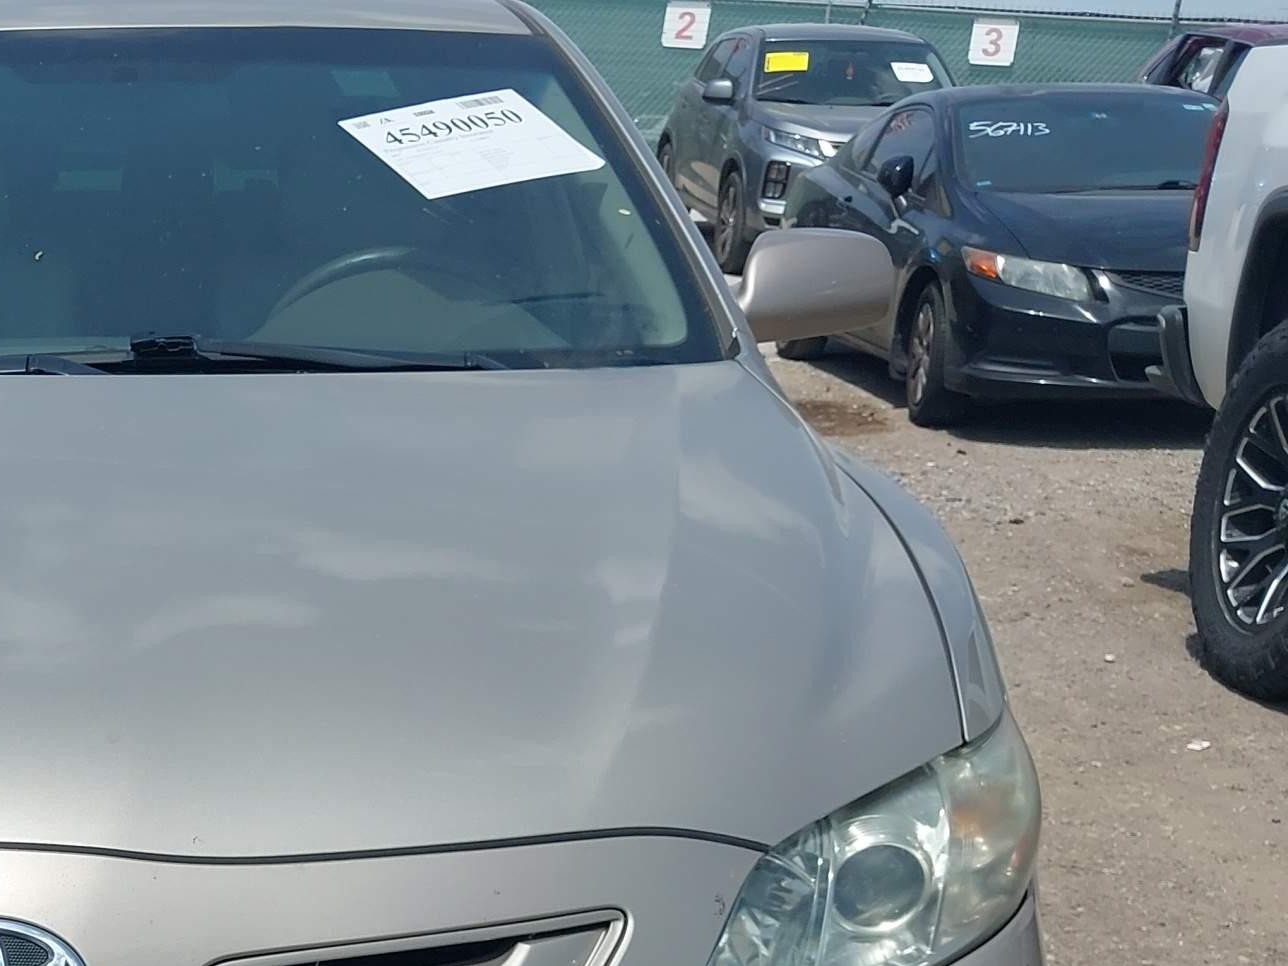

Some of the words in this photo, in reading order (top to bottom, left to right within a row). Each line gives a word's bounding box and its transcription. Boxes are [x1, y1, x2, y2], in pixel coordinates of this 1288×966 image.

[674, 11, 696, 41] 2
[981, 28, 1004, 57] 3
[385, 107, 523, 145] 45490050
